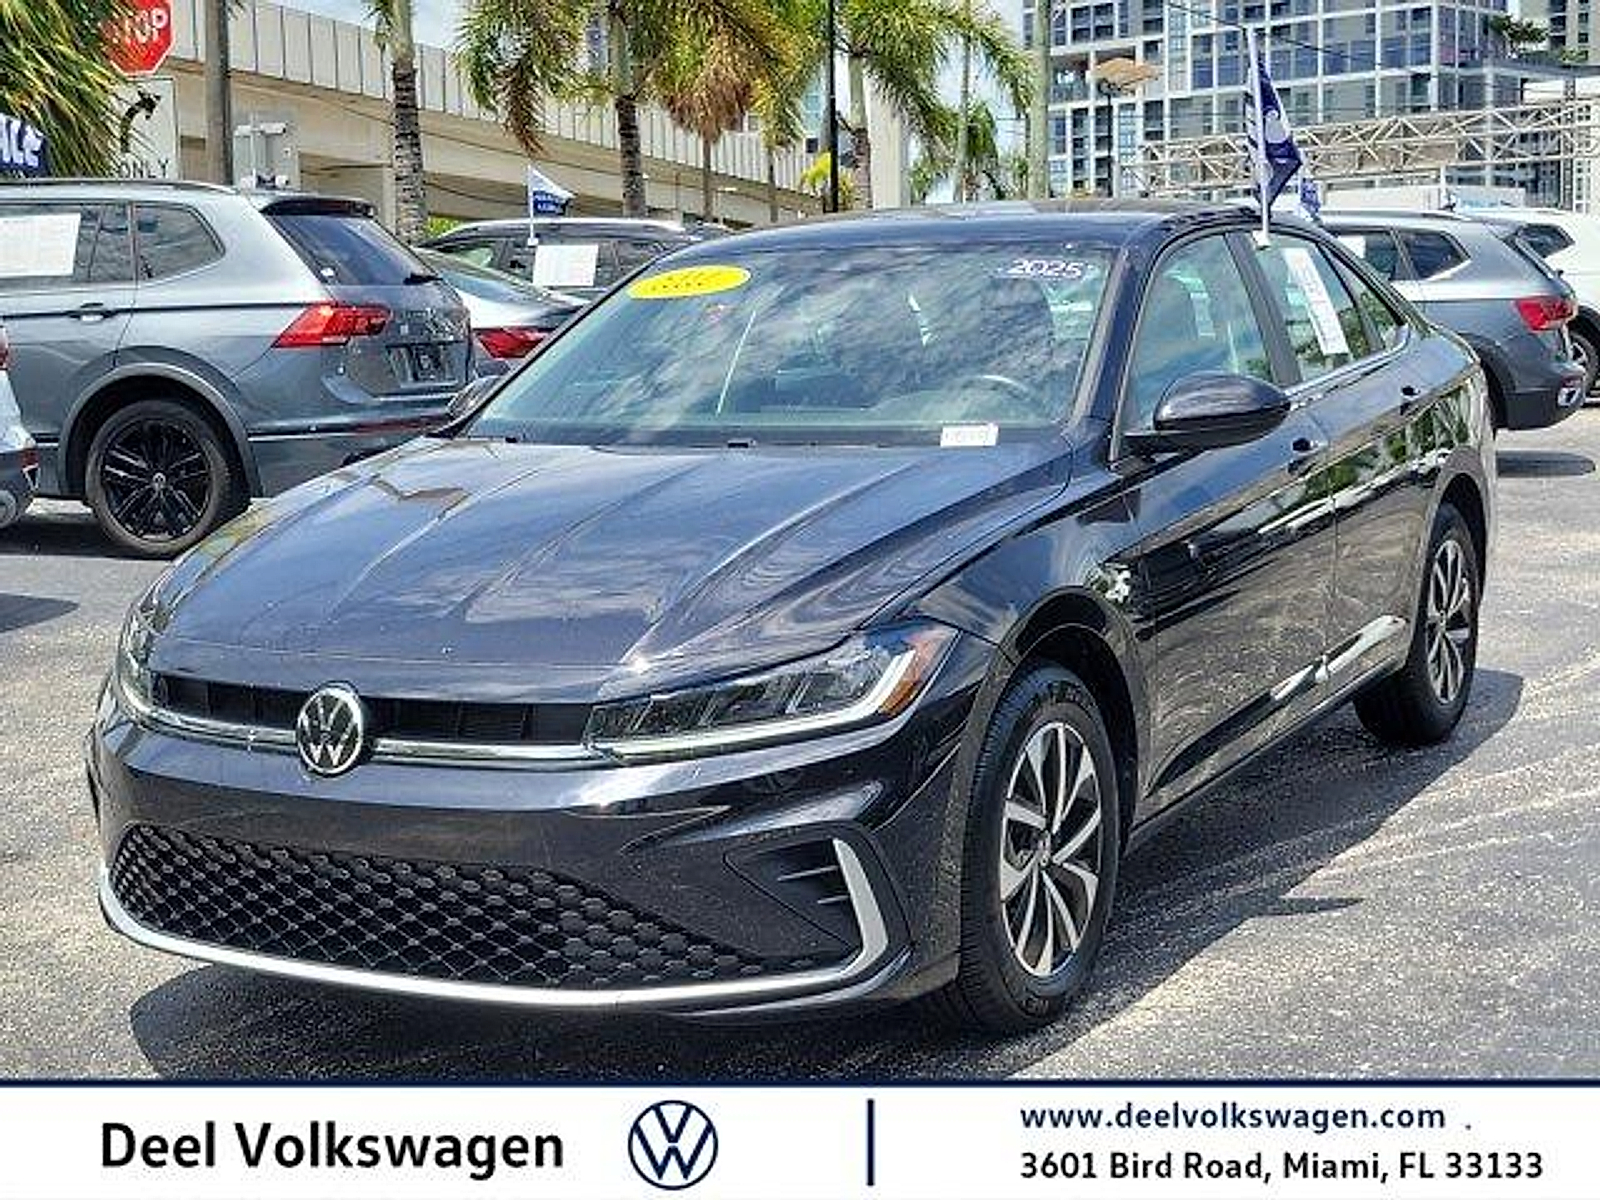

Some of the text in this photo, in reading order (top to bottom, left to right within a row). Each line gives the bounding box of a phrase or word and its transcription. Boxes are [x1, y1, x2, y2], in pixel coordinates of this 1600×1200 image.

[106, 7, 168, 43] TOP
[119, 159, 169, 179] ONLY
[1008, 260, 1083, 279] 2025
